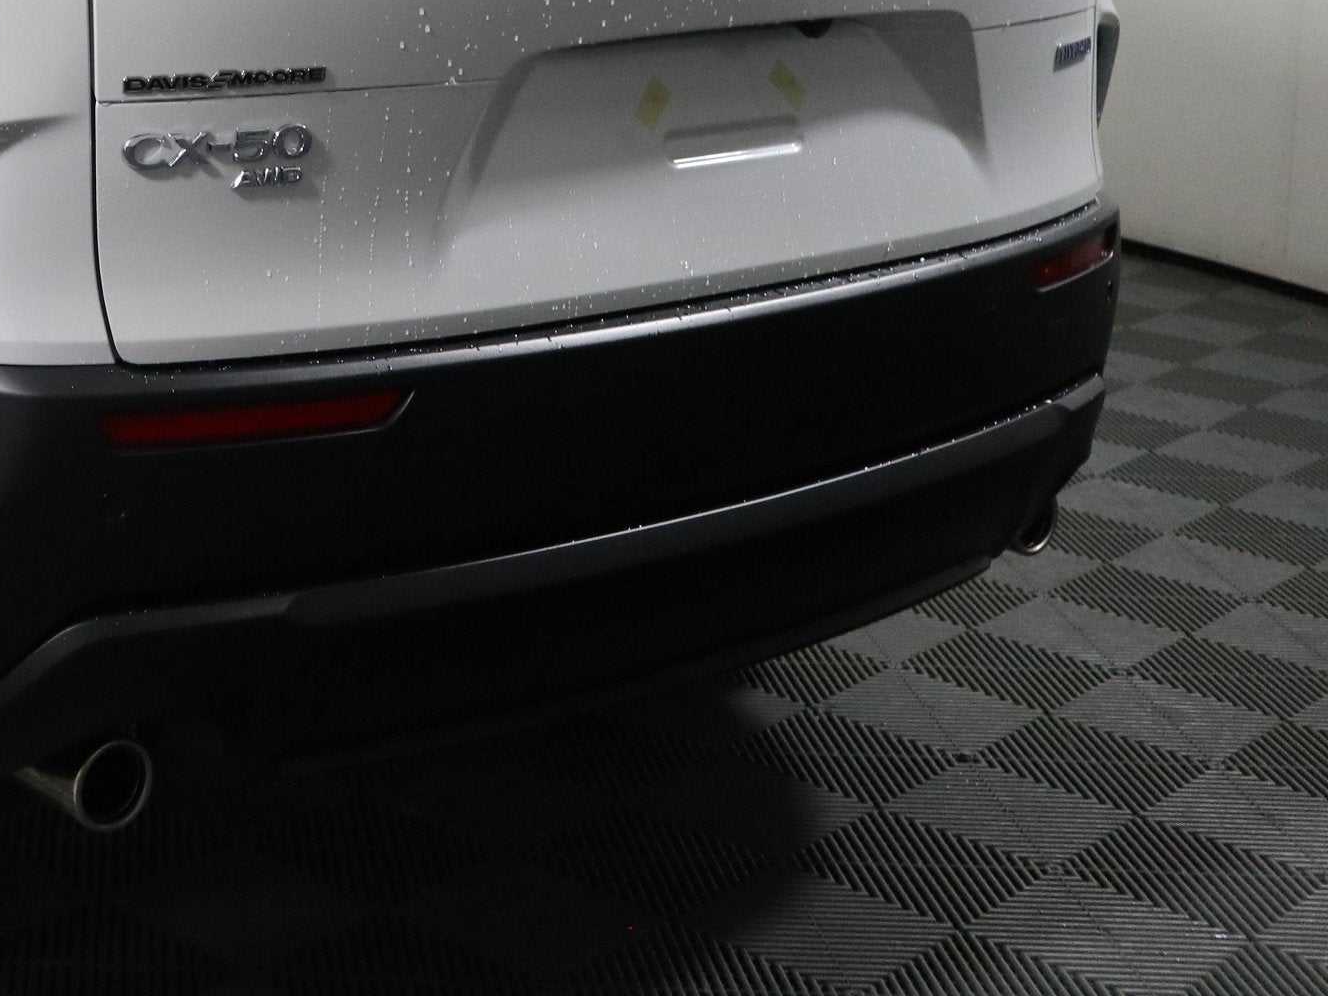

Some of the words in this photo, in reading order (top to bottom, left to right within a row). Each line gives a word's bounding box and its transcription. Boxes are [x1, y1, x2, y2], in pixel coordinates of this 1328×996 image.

[123, 72, 209, 94] DAVIS
[228, 66, 327, 88] MOORE
[123, 123, 312, 170] CX-50
[231, 166, 303, 189] AWD
